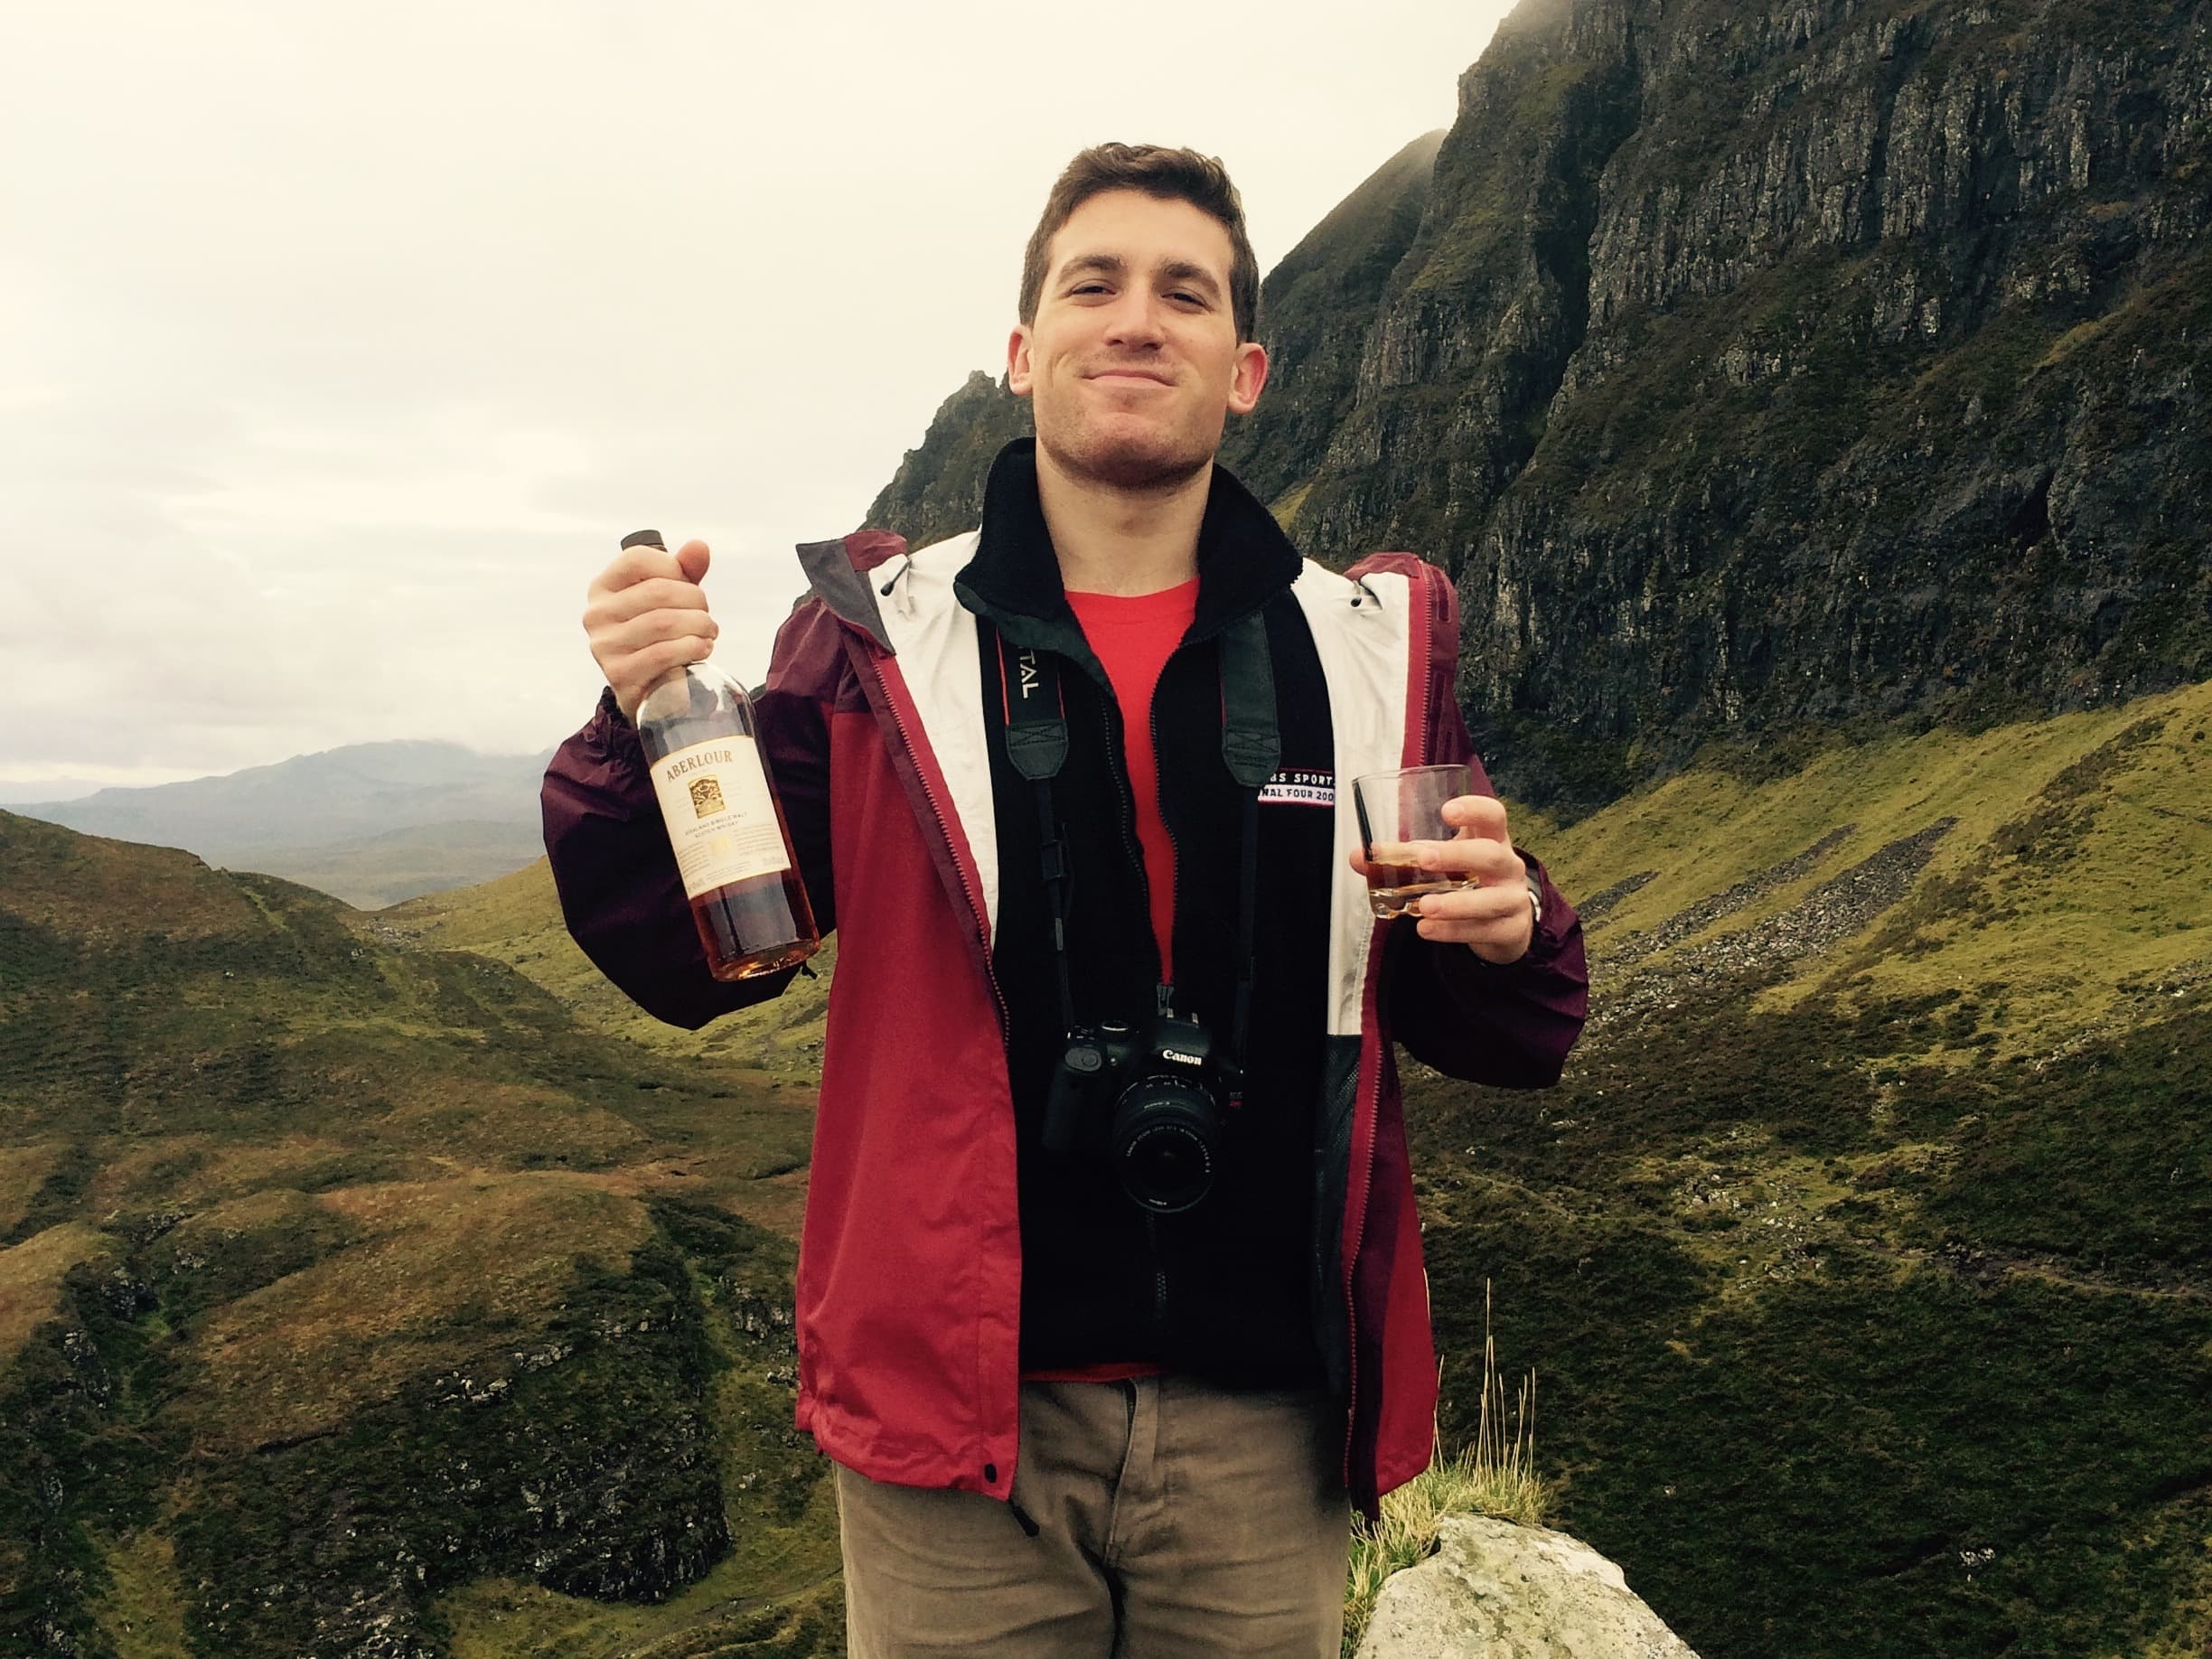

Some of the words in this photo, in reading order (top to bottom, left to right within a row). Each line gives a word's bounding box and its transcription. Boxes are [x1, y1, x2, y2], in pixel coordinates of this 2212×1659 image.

[666, 750, 733, 783] ABERLOUR
[1286, 788, 1313, 799] FOUR
[1162, 1049, 1202, 1065] Canon
